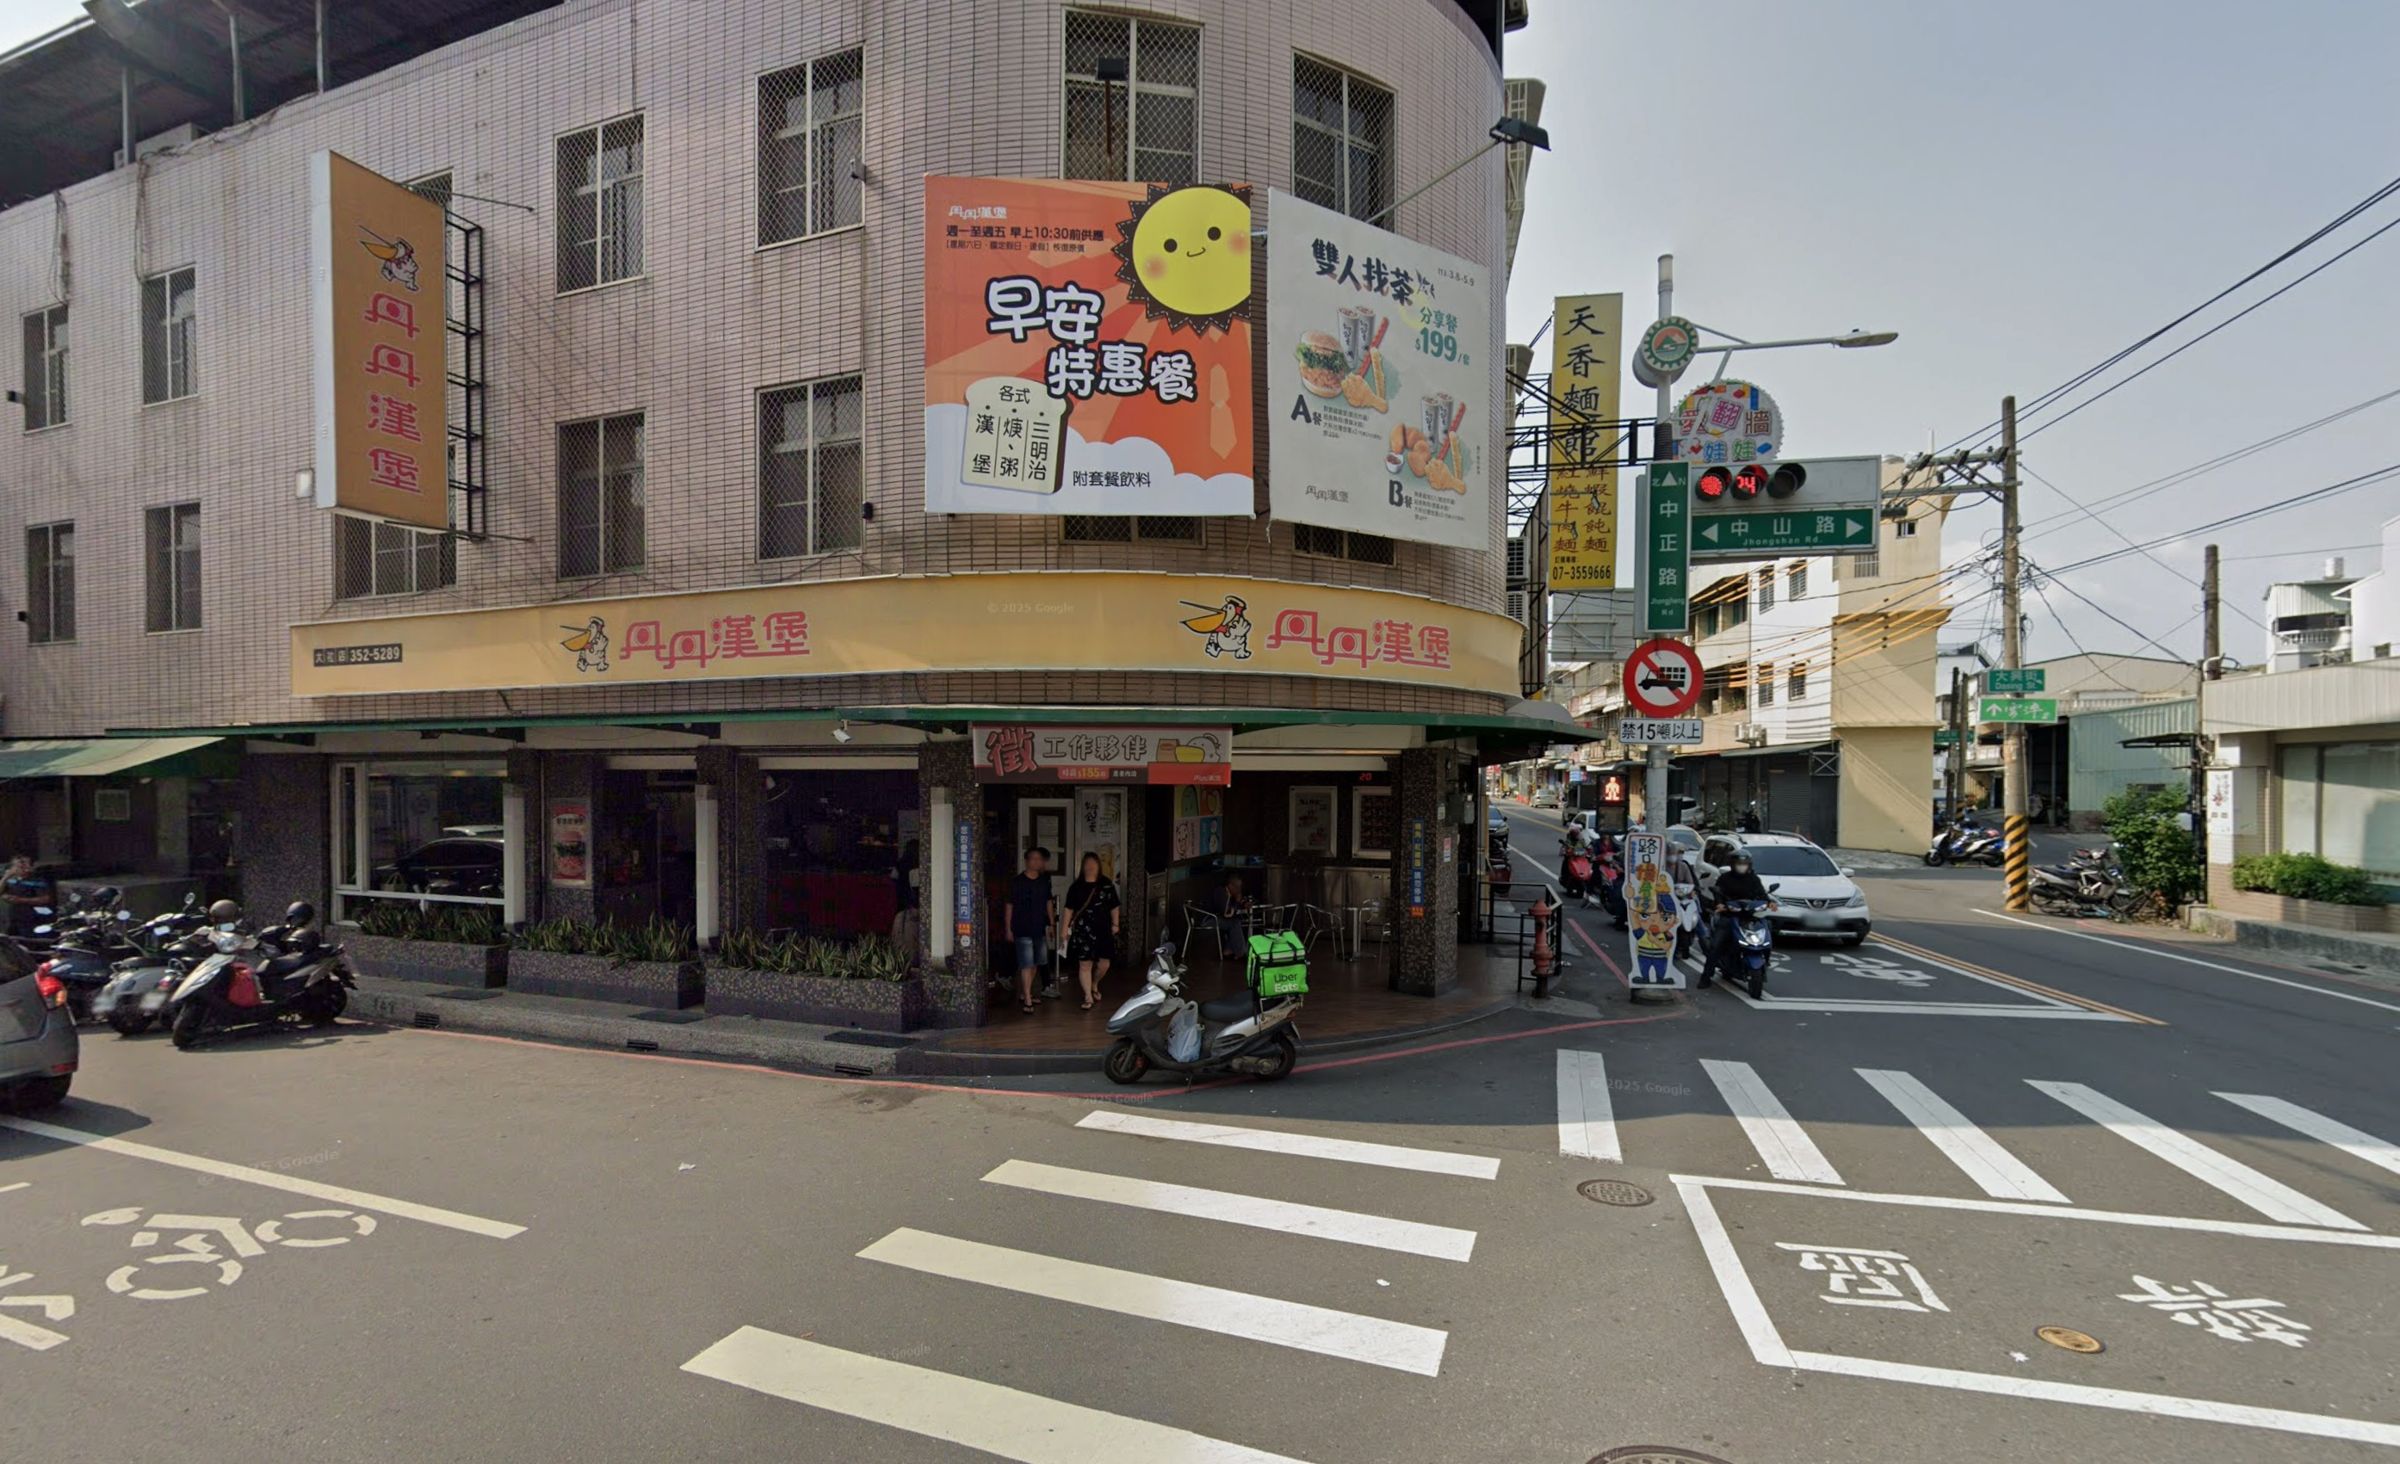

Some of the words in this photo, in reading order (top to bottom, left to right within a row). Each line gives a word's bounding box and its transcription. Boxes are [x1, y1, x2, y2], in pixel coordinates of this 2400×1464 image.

[946, 225, 1006, 239] 週一至週五
[1010, 226, 1105, 242] 早上10:30前供應
[986, 278, 1104, 345] 早安
[1420, 306, 1458, 334] 分享餐
[1047, 343, 1197, 401] 特惠餐
[362, 292, 422, 495] 丹丹漢堡
[999, 386, 1030, 404] 各式
[1028, 421, 1051, 481] 三明治
[1703, 440, 1757, 463] 娃娃
[1072, 472, 1151, 488] 附套餐飲料
[1730, 515, 1835, 537] 中山路
[1659, 500, 1679, 586] 中正路
[1743, 537, 1800, 546] Jhongshan
[1553, 565, 1611, 581] 07-3559666
[619, 610, 811, 669] 丹丹漢堡
[1265, 607, 1451, 669] 丹丹漢堡
[350, 646, 401, 662] 352-5289
[1621, 720, 1702, 741] 禁15噸以上
[986, 727, 1038, 777] 徵
[1043, 734, 1147, 761] 工作夥伴
[1274, 973, 1297, 983] Uber
[1274, 983, 1299, 993] Eats
